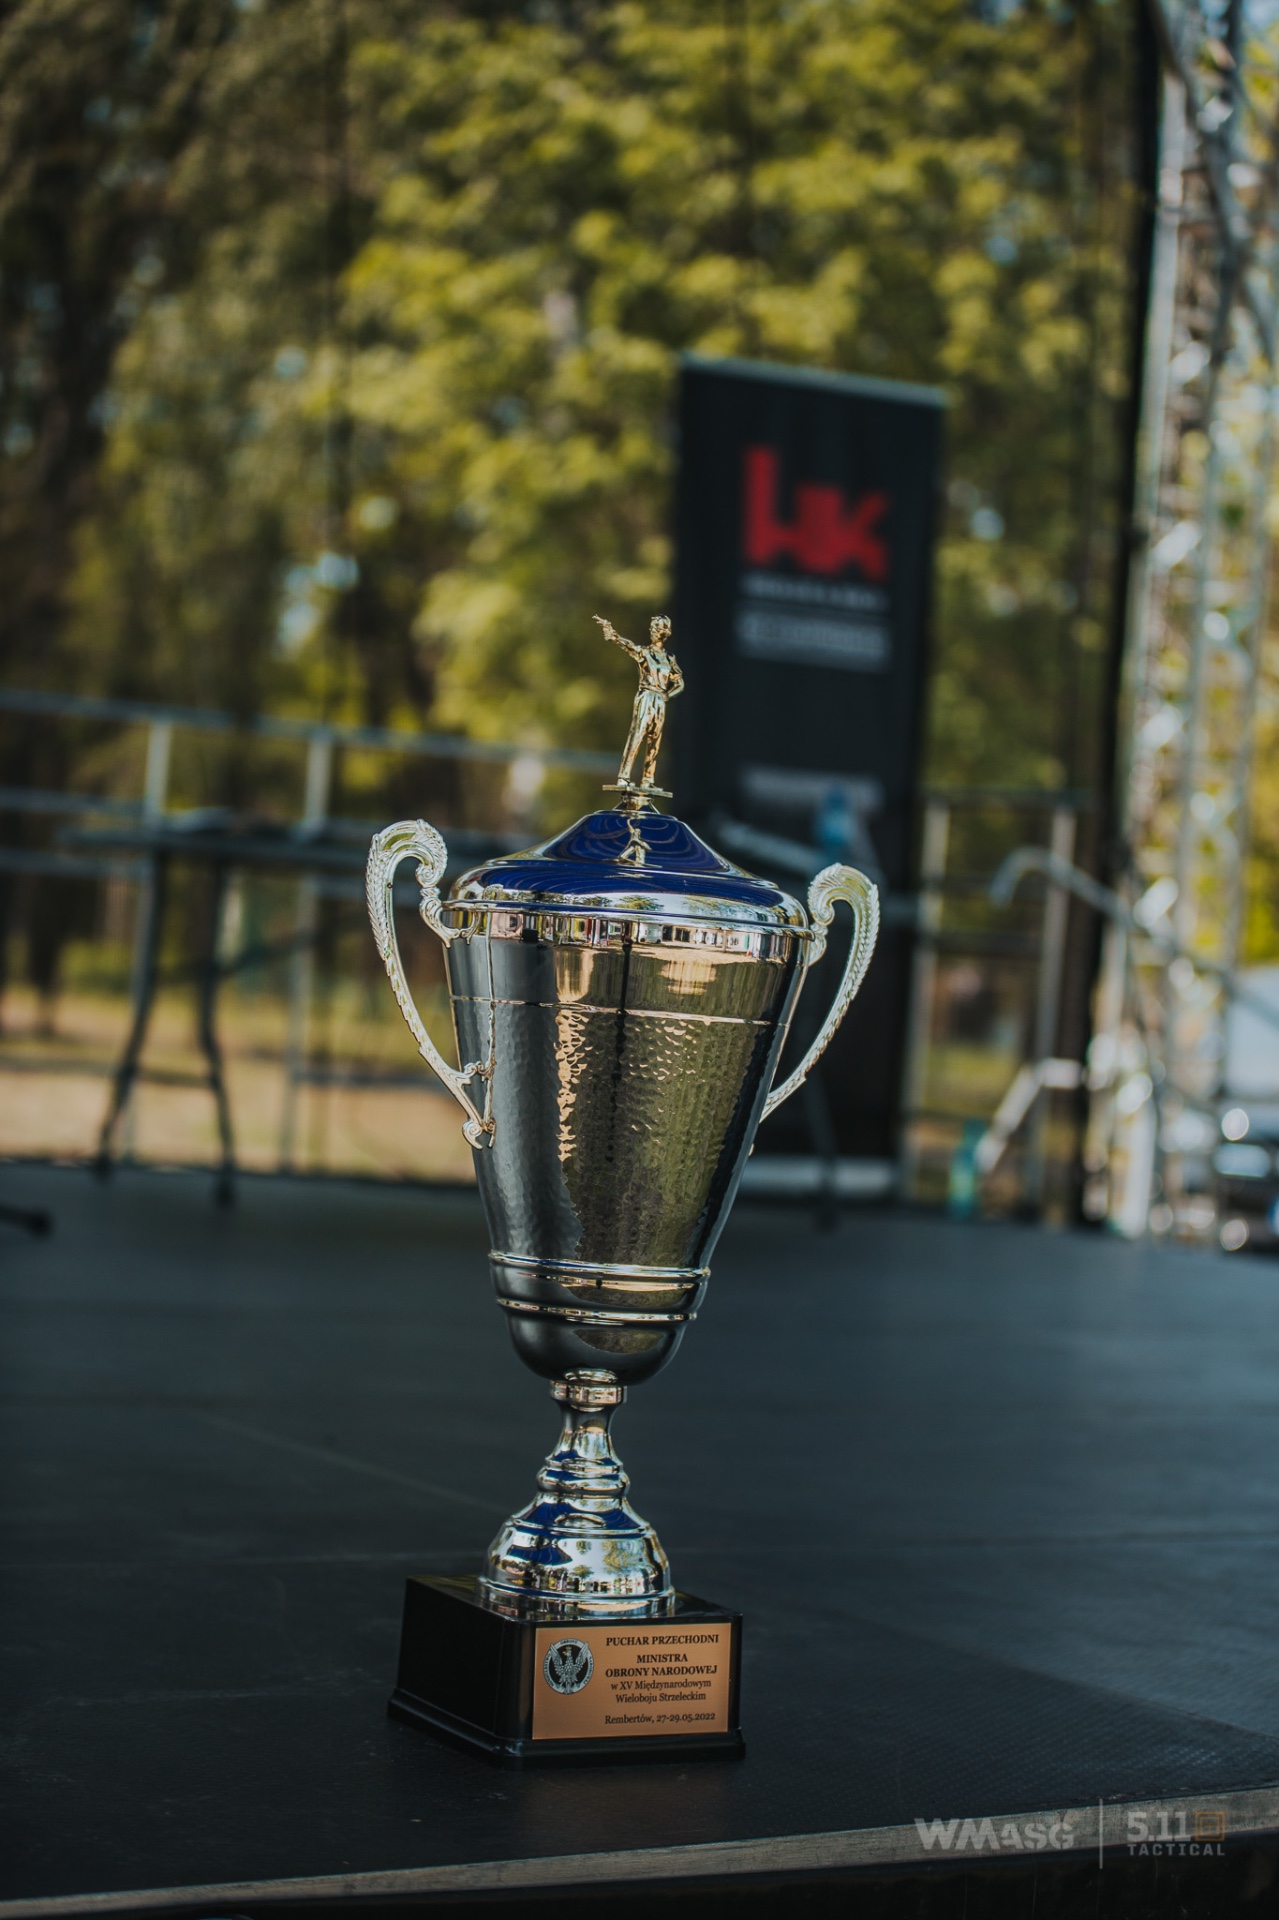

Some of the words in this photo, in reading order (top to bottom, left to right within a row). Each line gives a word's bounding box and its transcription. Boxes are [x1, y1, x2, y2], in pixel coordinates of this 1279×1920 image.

[606, 1637, 649, 1646] PUCHAR
[652, 1634, 719, 1645] PRZECHODNI
[637, 1654, 688, 1663] MINISTRA
[605, 1667, 650, 1677] OBRONY
[651, 1665, 717, 1676] NARODOWEJ
[620, 1681, 633, 1690] XV
[634, 1679, 711, 1692] Międzynarodowym
[616, 1693, 658, 1704] Wieloboju
[659, 1691, 706, 1702] Strzeleckim
[605, 1714, 654, 1724] Rembertów,
[656, 1712, 715, 1723] 27-29.05.2022
